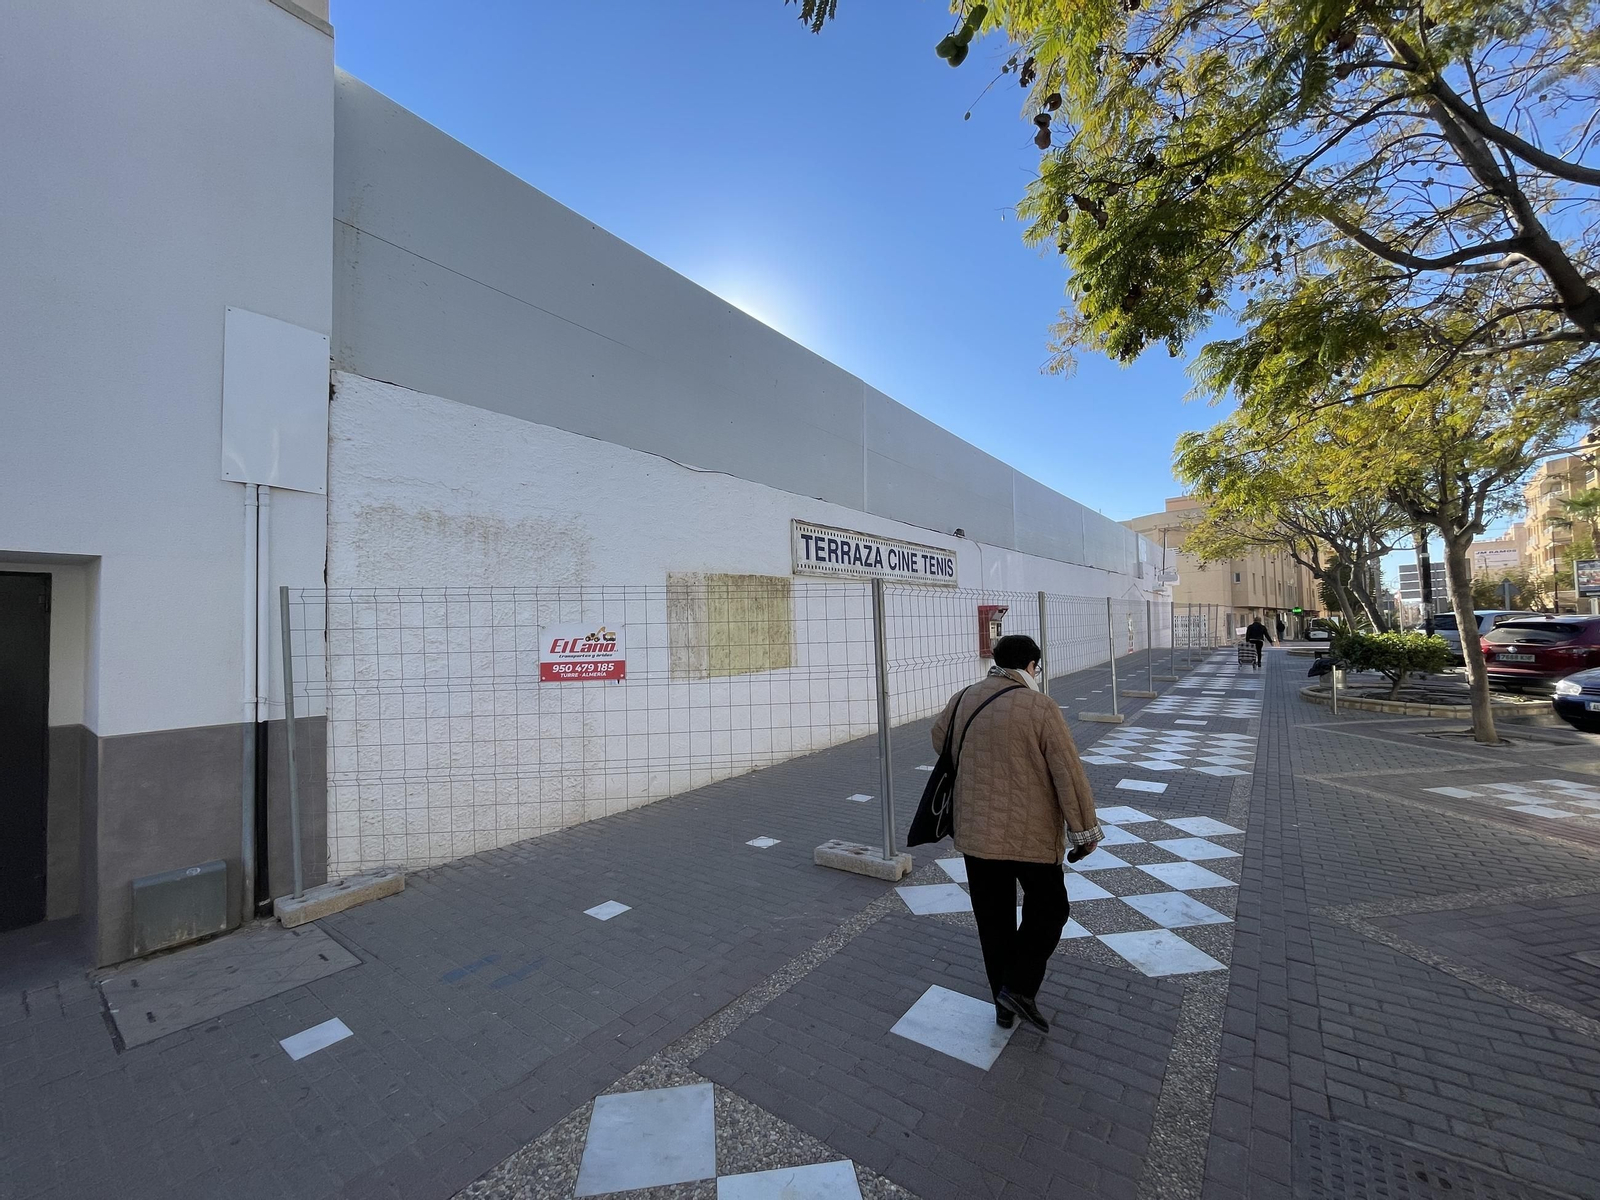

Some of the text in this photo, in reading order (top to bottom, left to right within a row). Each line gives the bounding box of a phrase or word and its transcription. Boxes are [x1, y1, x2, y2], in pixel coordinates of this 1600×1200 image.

[801, 534, 954, 578] TERRAZA CINE TENIS
[552, 662, 615, 673] 950 479 185
